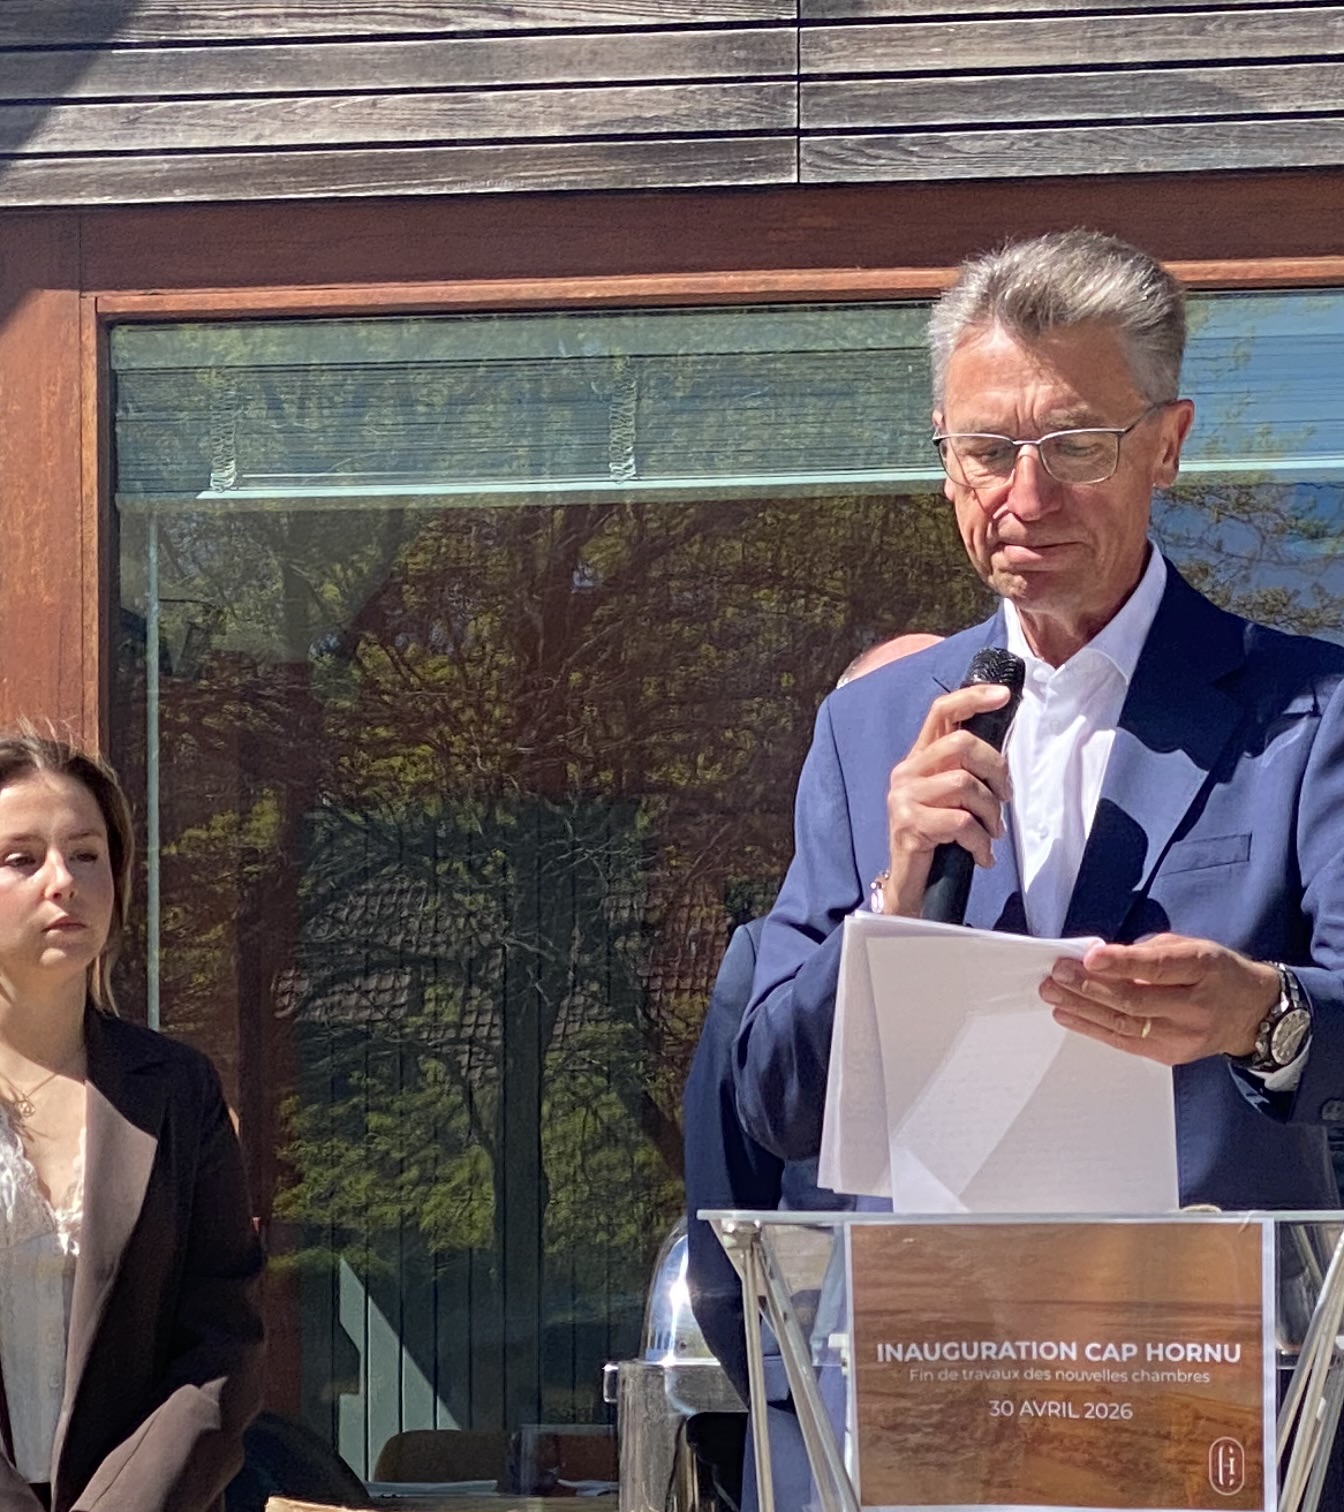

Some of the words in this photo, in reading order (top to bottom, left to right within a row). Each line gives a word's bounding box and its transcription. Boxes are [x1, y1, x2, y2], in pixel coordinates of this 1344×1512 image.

[877, 1341, 1077, 1362] INAUGURATION
[1085, 1342, 1137, 1362] CAP
[1146, 1343, 1241, 1363] HORNU
[910, 1368, 934, 1382] Fin
[938, 1368, 958, 1381] de
[962, 1369, 1019, 1381] travaux
[1023, 1367, 1051, 1381] des
[1056, 1369, 1128, 1383] nouvelles
[1131, 1369, 1211, 1383] chambres
[989, 1400, 1014, 1417] 30
[1020, 1400, 1080, 1418] AVRIL
[1084, 1402, 1133, 1420] 2026
